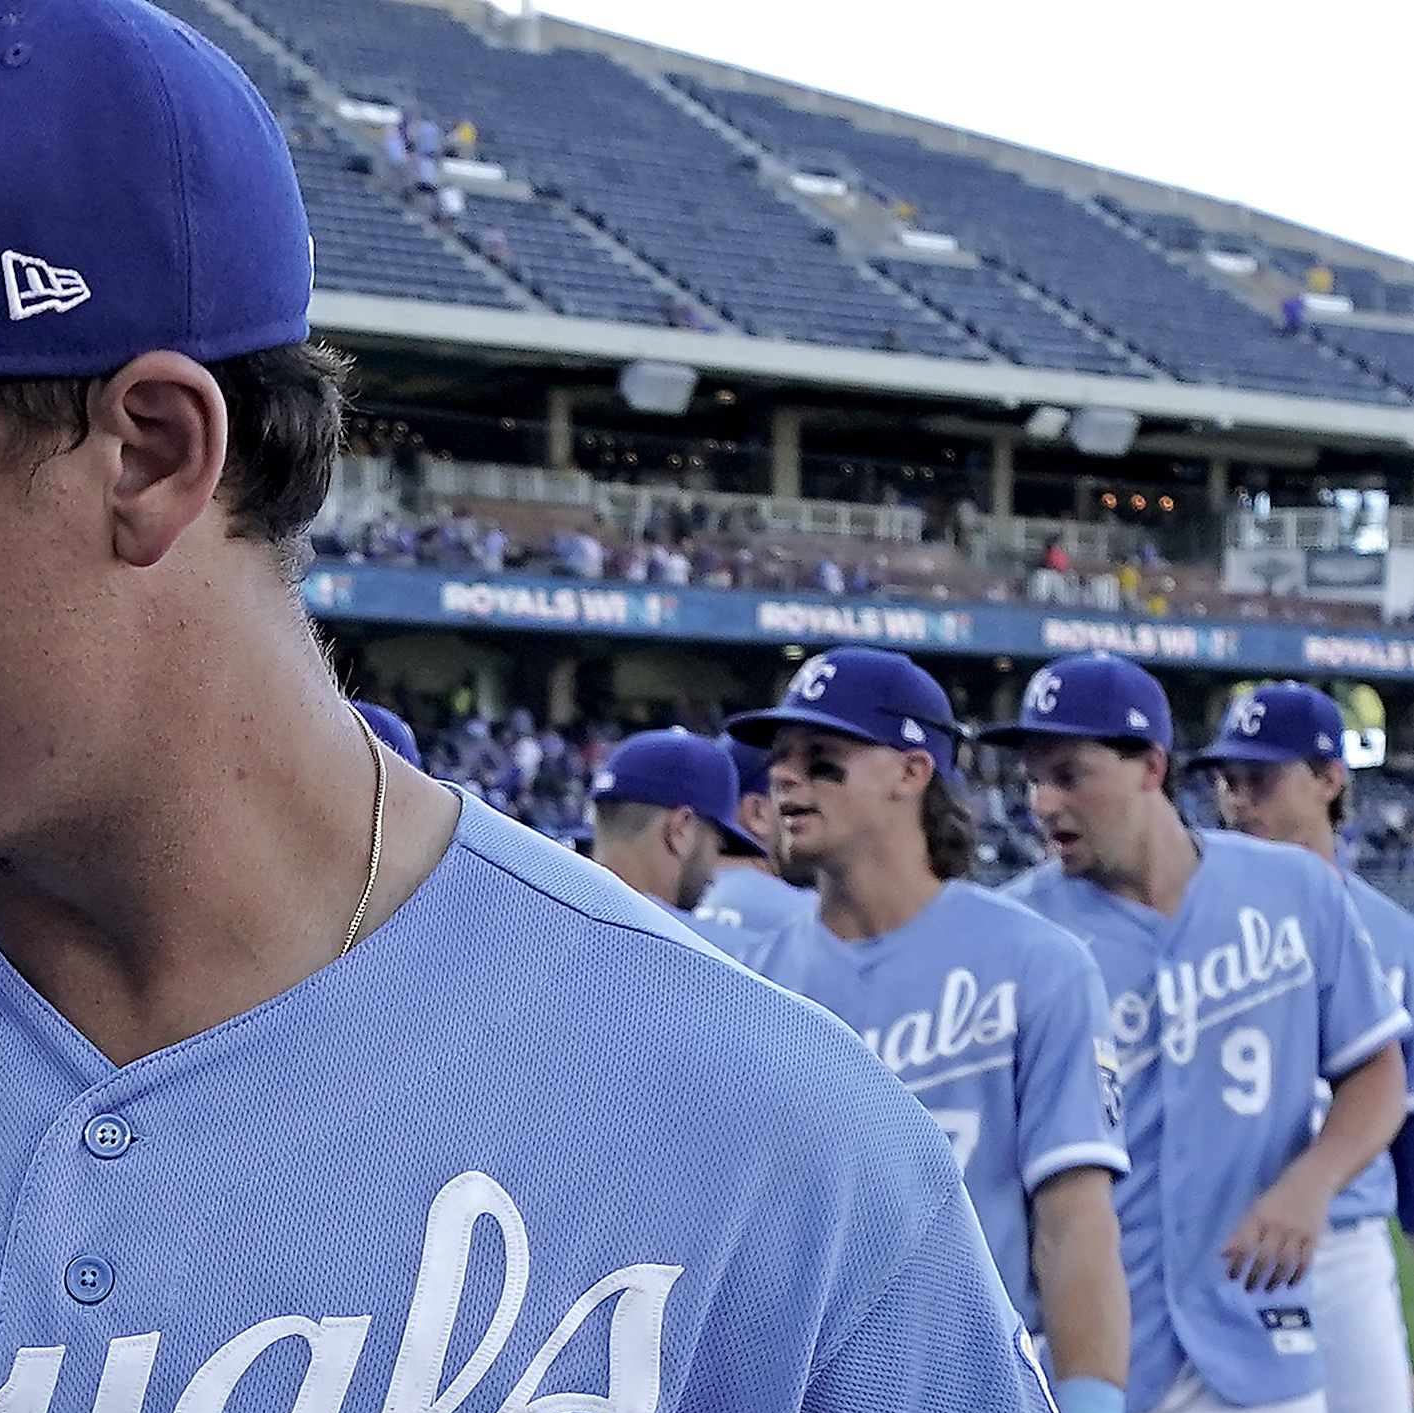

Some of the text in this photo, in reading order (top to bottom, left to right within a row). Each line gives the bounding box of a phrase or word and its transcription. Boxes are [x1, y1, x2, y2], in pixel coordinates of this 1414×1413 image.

[439, 580, 578, 623] ROYALS
[756, 600, 883, 640] ROYALS
[1111, 905, 1314, 1065] oyals
[1221, 1027, 1273, 1114] 9
